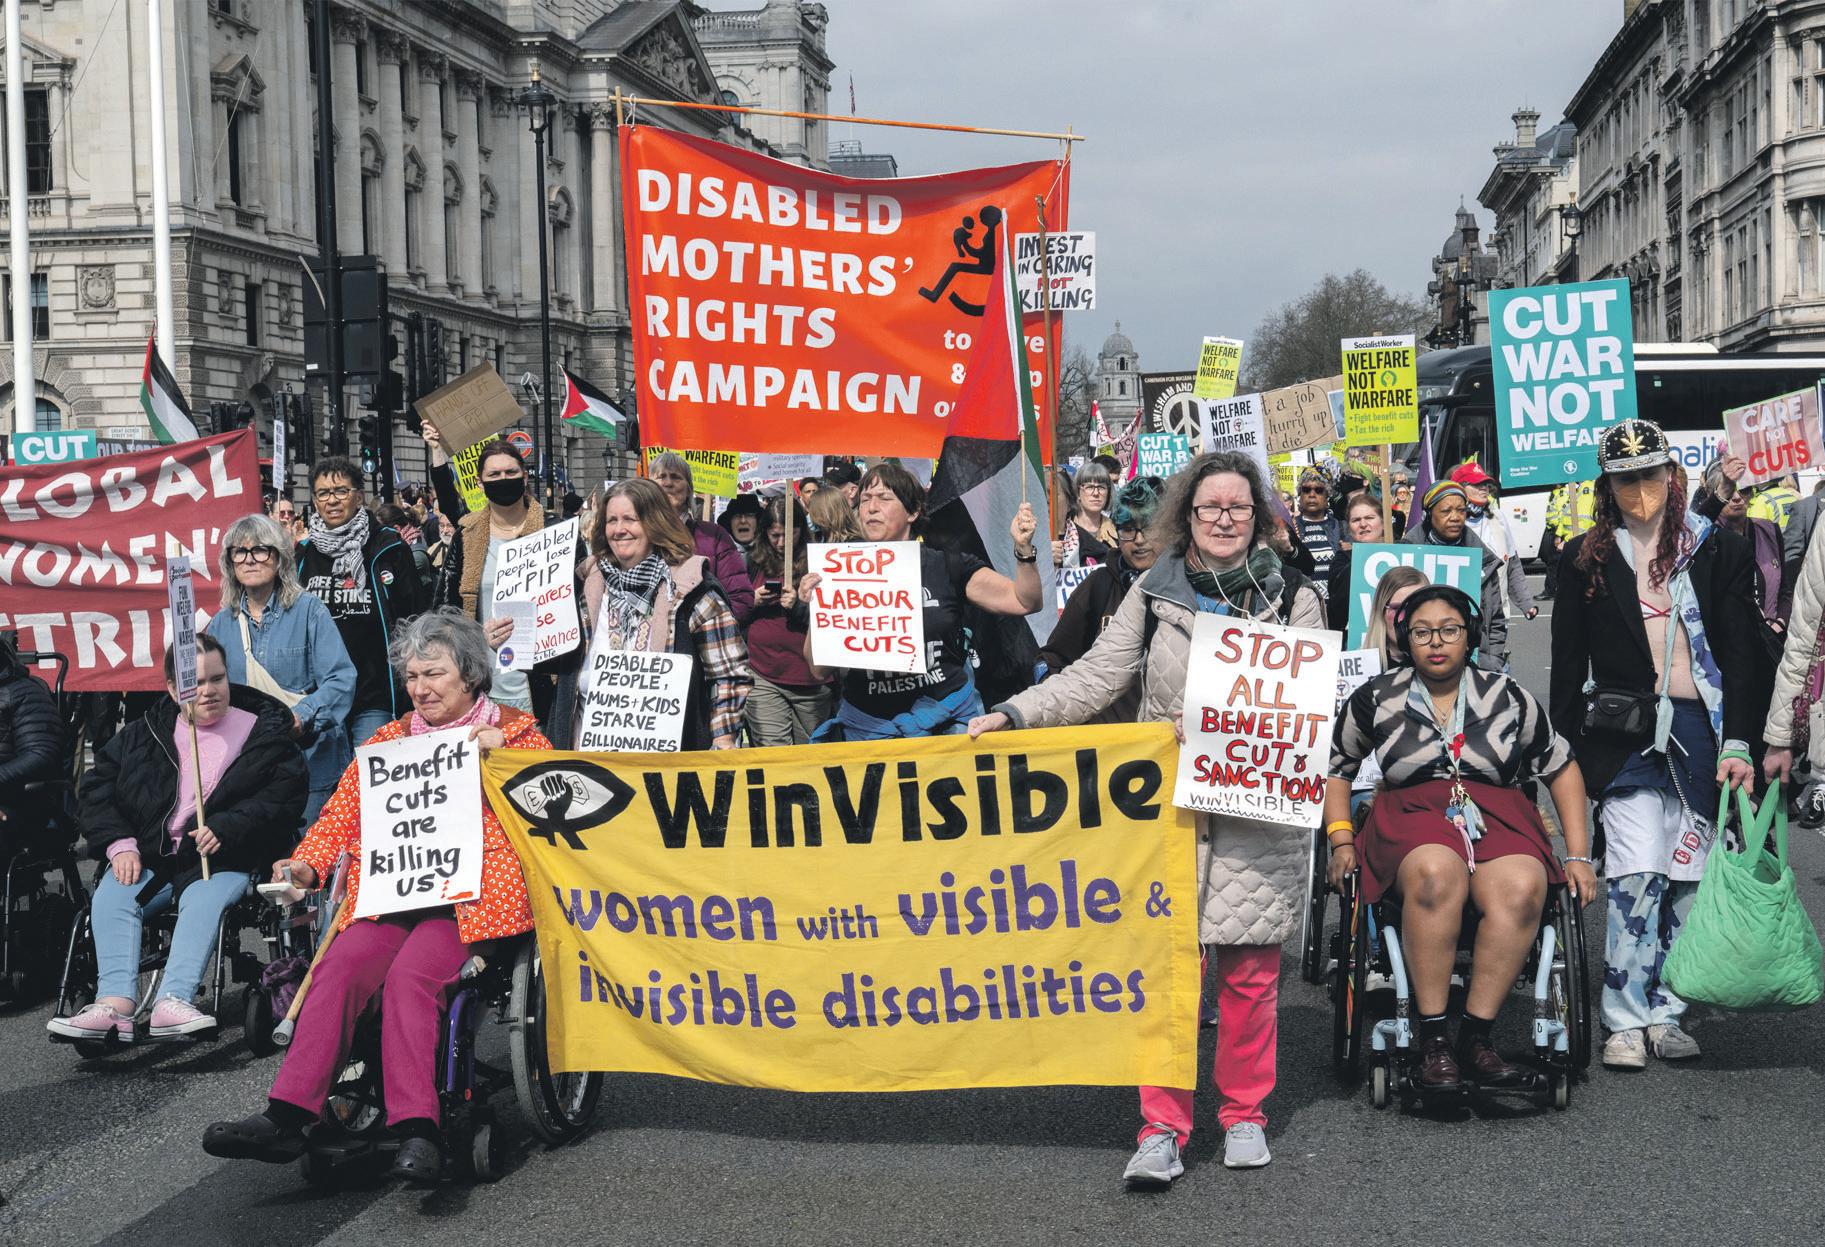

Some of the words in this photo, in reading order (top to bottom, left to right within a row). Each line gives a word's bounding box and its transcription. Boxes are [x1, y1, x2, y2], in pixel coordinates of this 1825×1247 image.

[637, 169, 903, 237] DISABLED
[641, 233, 915, 298] MOTHERS'
[1018, 259, 1031, 276] IN
[1033, 254, 1094, 277] CARING
[645, 294, 837, 349] RIGHTS
[1502, 288, 1618, 340] CUT
[944, 329, 972, 350] to
[1204, 344, 1239, 359] WELFARE
[1201, 356, 1216, 367] NOT
[1347, 350, 1410, 371] WELFARE
[1501, 335, 1625, 383] WAR
[647, 358, 921, 416] CAMPAIGN
[1175, 382, 1193, 392] AND
[1200, 366, 1235, 381] WARFARE
[1348, 372, 1377, 390] NOT
[1208, 400, 1253, 421] WELFARE
[1276, 398, 1287, 411] a
[1294, 385, 1315, 418] job
[1348, 389, 1413, 410] WARFARE
[1508, 378, 1625, 430] NOT
[1211, 420, 1231, 436] NOT
[1269, 417, 1307, 436] hurry
[1313, 410, 1327, 428] up
[1741, 395, 1802, 434] CARE
[1141, 435, 1171, 450] CUT
[1213, 431, 1257, 451] WARFARE
[1765, 426, 1786, 442] NOT
[21, 435, 89, 462] CUT
[685, 450, 737, 470] WARFARE
[1140, 449, 1172, 463] WAR
[1748, 440, 1810, 476] CUTS
[1141, 463, 1172, 478] NOT
[506, 522, 574, 563] Disabled
[496, 557, 538, 587] people
[546, 546, 571, 564] lose
[822, 548, 895, 575] STOP
[495, 581, 524, 602] our
[525, 562, 560, 592] PIP
[815, 587, 914, 611] LABOUR
[815, 612, 912, 633] BENEFIT
[843, 635, 916, 655] CUTS
[1214, 628, 1324, 679] STOP
[594, 653, 674, 675] DISABLED
[868, 668, 946, 695] PALESTINE
[1227, 674, 1297, 710] ALL
[591, 711, 656, 731] STARVE
[1200, 706, 1329, 749] BENEFIT
[582, 731, 678, 753] BILLIONAIRES
[1226, 738, 1294, 770] CUT
[368, 740, 470, 788] Benefit
[1194, 754, 1327, 805] SANCTIONS
[385, 780, 448, 814] cuts
[643, 748, 1163, 849] WinVisible
[391, 815, 437, 839] are
[369, 844, 461, 879] killing
[552, 885, 777, 941] women
[797, 904, 878, 940] with
[898, 859, 1122, 936] visible
[1145, 880, 1172, 918] &
[578, 950, 797, 1030] invisible
[823, 960, 1146, 1029] disabilities
